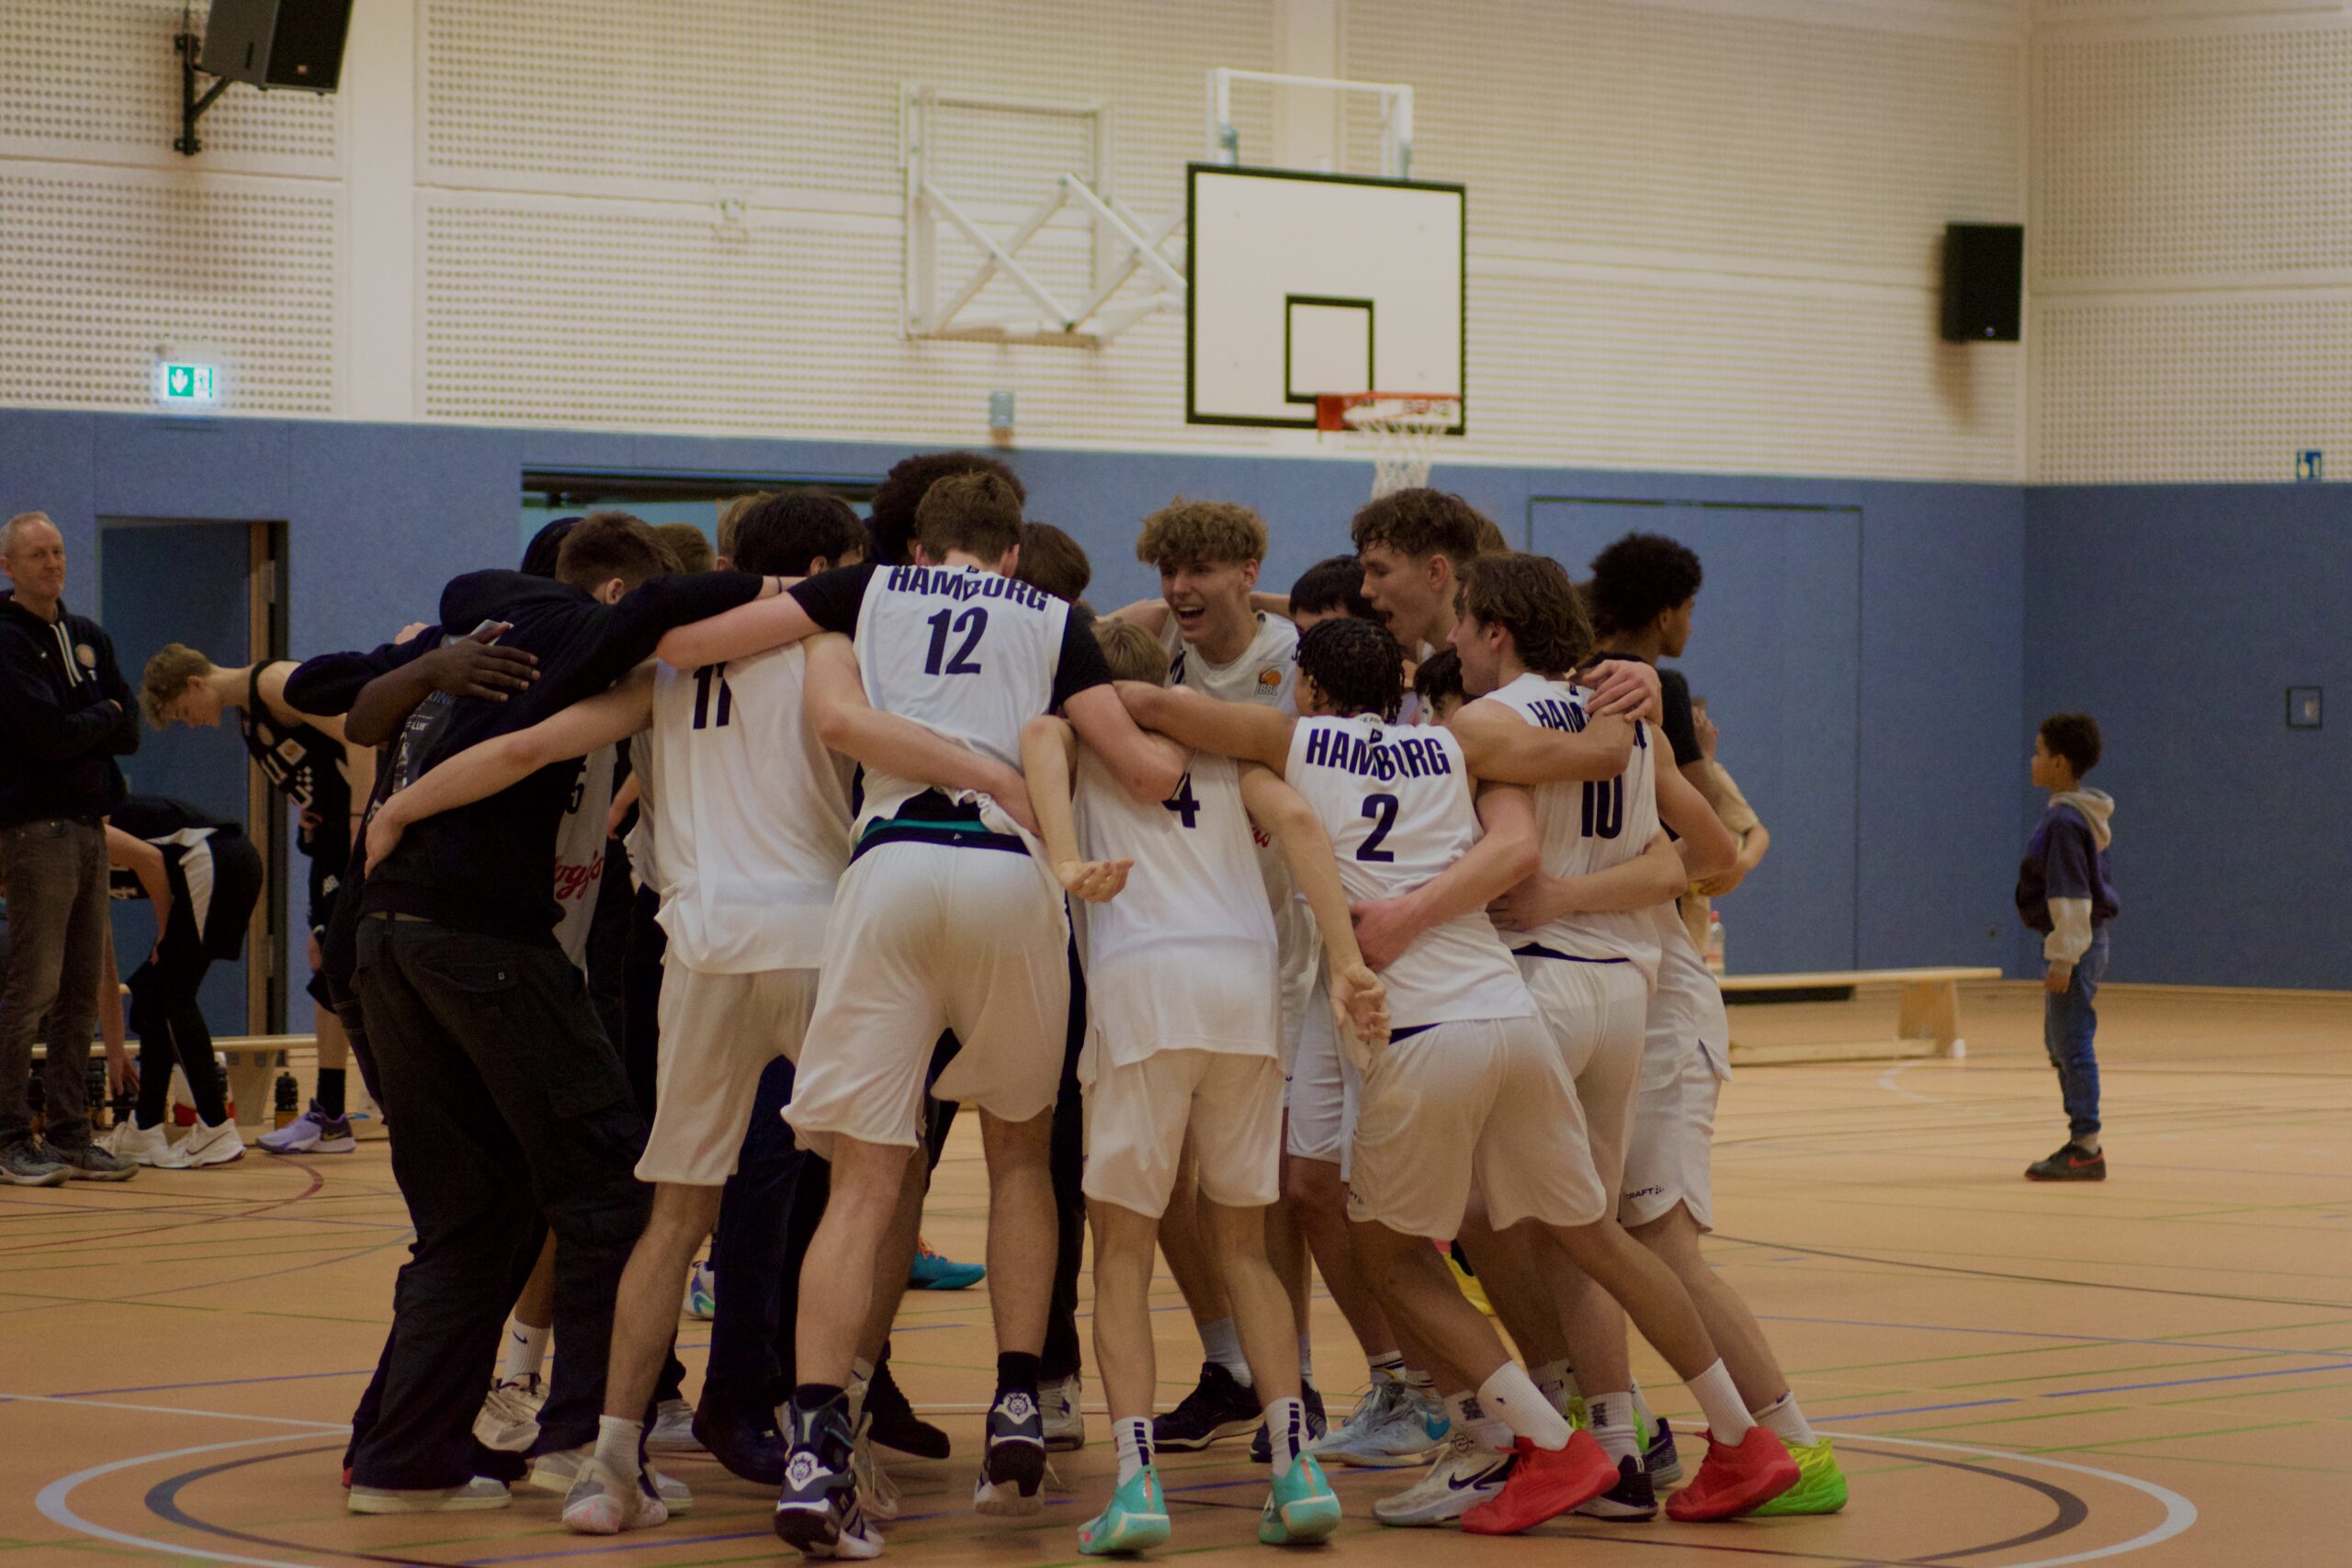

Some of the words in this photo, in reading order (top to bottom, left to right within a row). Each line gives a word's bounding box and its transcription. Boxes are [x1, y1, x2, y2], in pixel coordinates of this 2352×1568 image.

[887, 566, 1049, 612] HAMBURG
[924, 606, 989, 676] 12
[693, 661, 732, 729] 11
[1306, 728, 1452, 781] HAMBURG
[1161, 771, 1201, 829] 4
[1356, 793, 1399, 863] 2
[1581, 774, 1623, 840] 10
